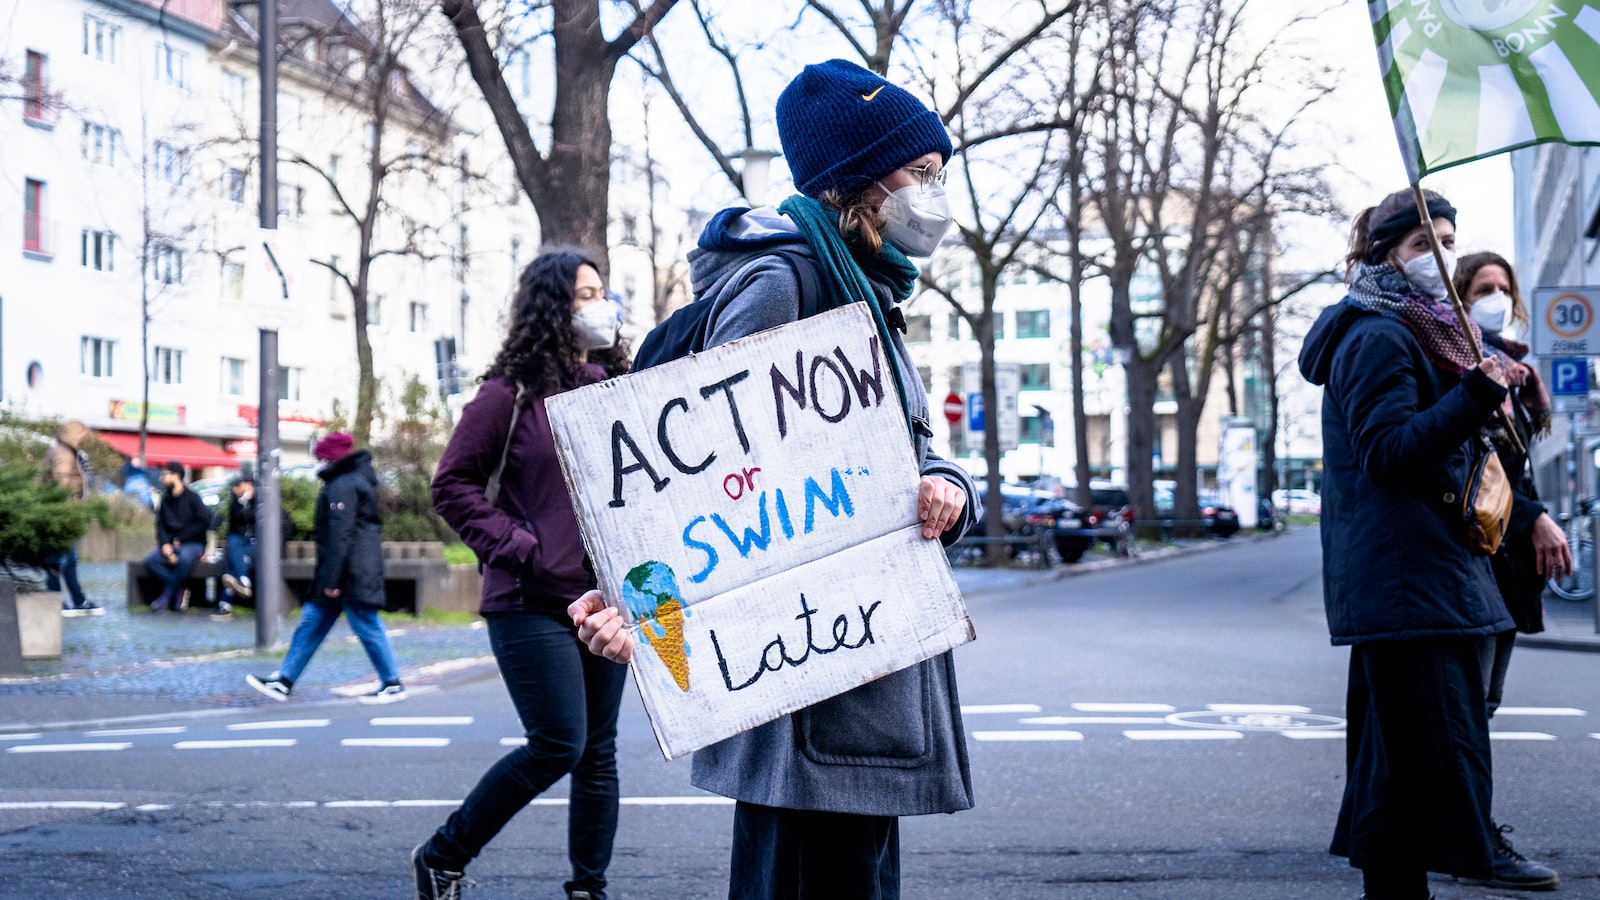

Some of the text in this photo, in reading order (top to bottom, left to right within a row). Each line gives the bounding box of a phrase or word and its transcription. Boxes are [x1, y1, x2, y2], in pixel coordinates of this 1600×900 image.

[1492, 4, 1567, 58] BONN
[1555, 304, 1584, 327] 30
[1551, 339, 1587, 351] ZONE
[1558, 364, 1577, 389] P
[608, 335, 885, 508] ACT NOW
[723, 466, 761, 500] or
[682, 467, 855, 584] SWIM
[710, 593, 882, 692] Later
